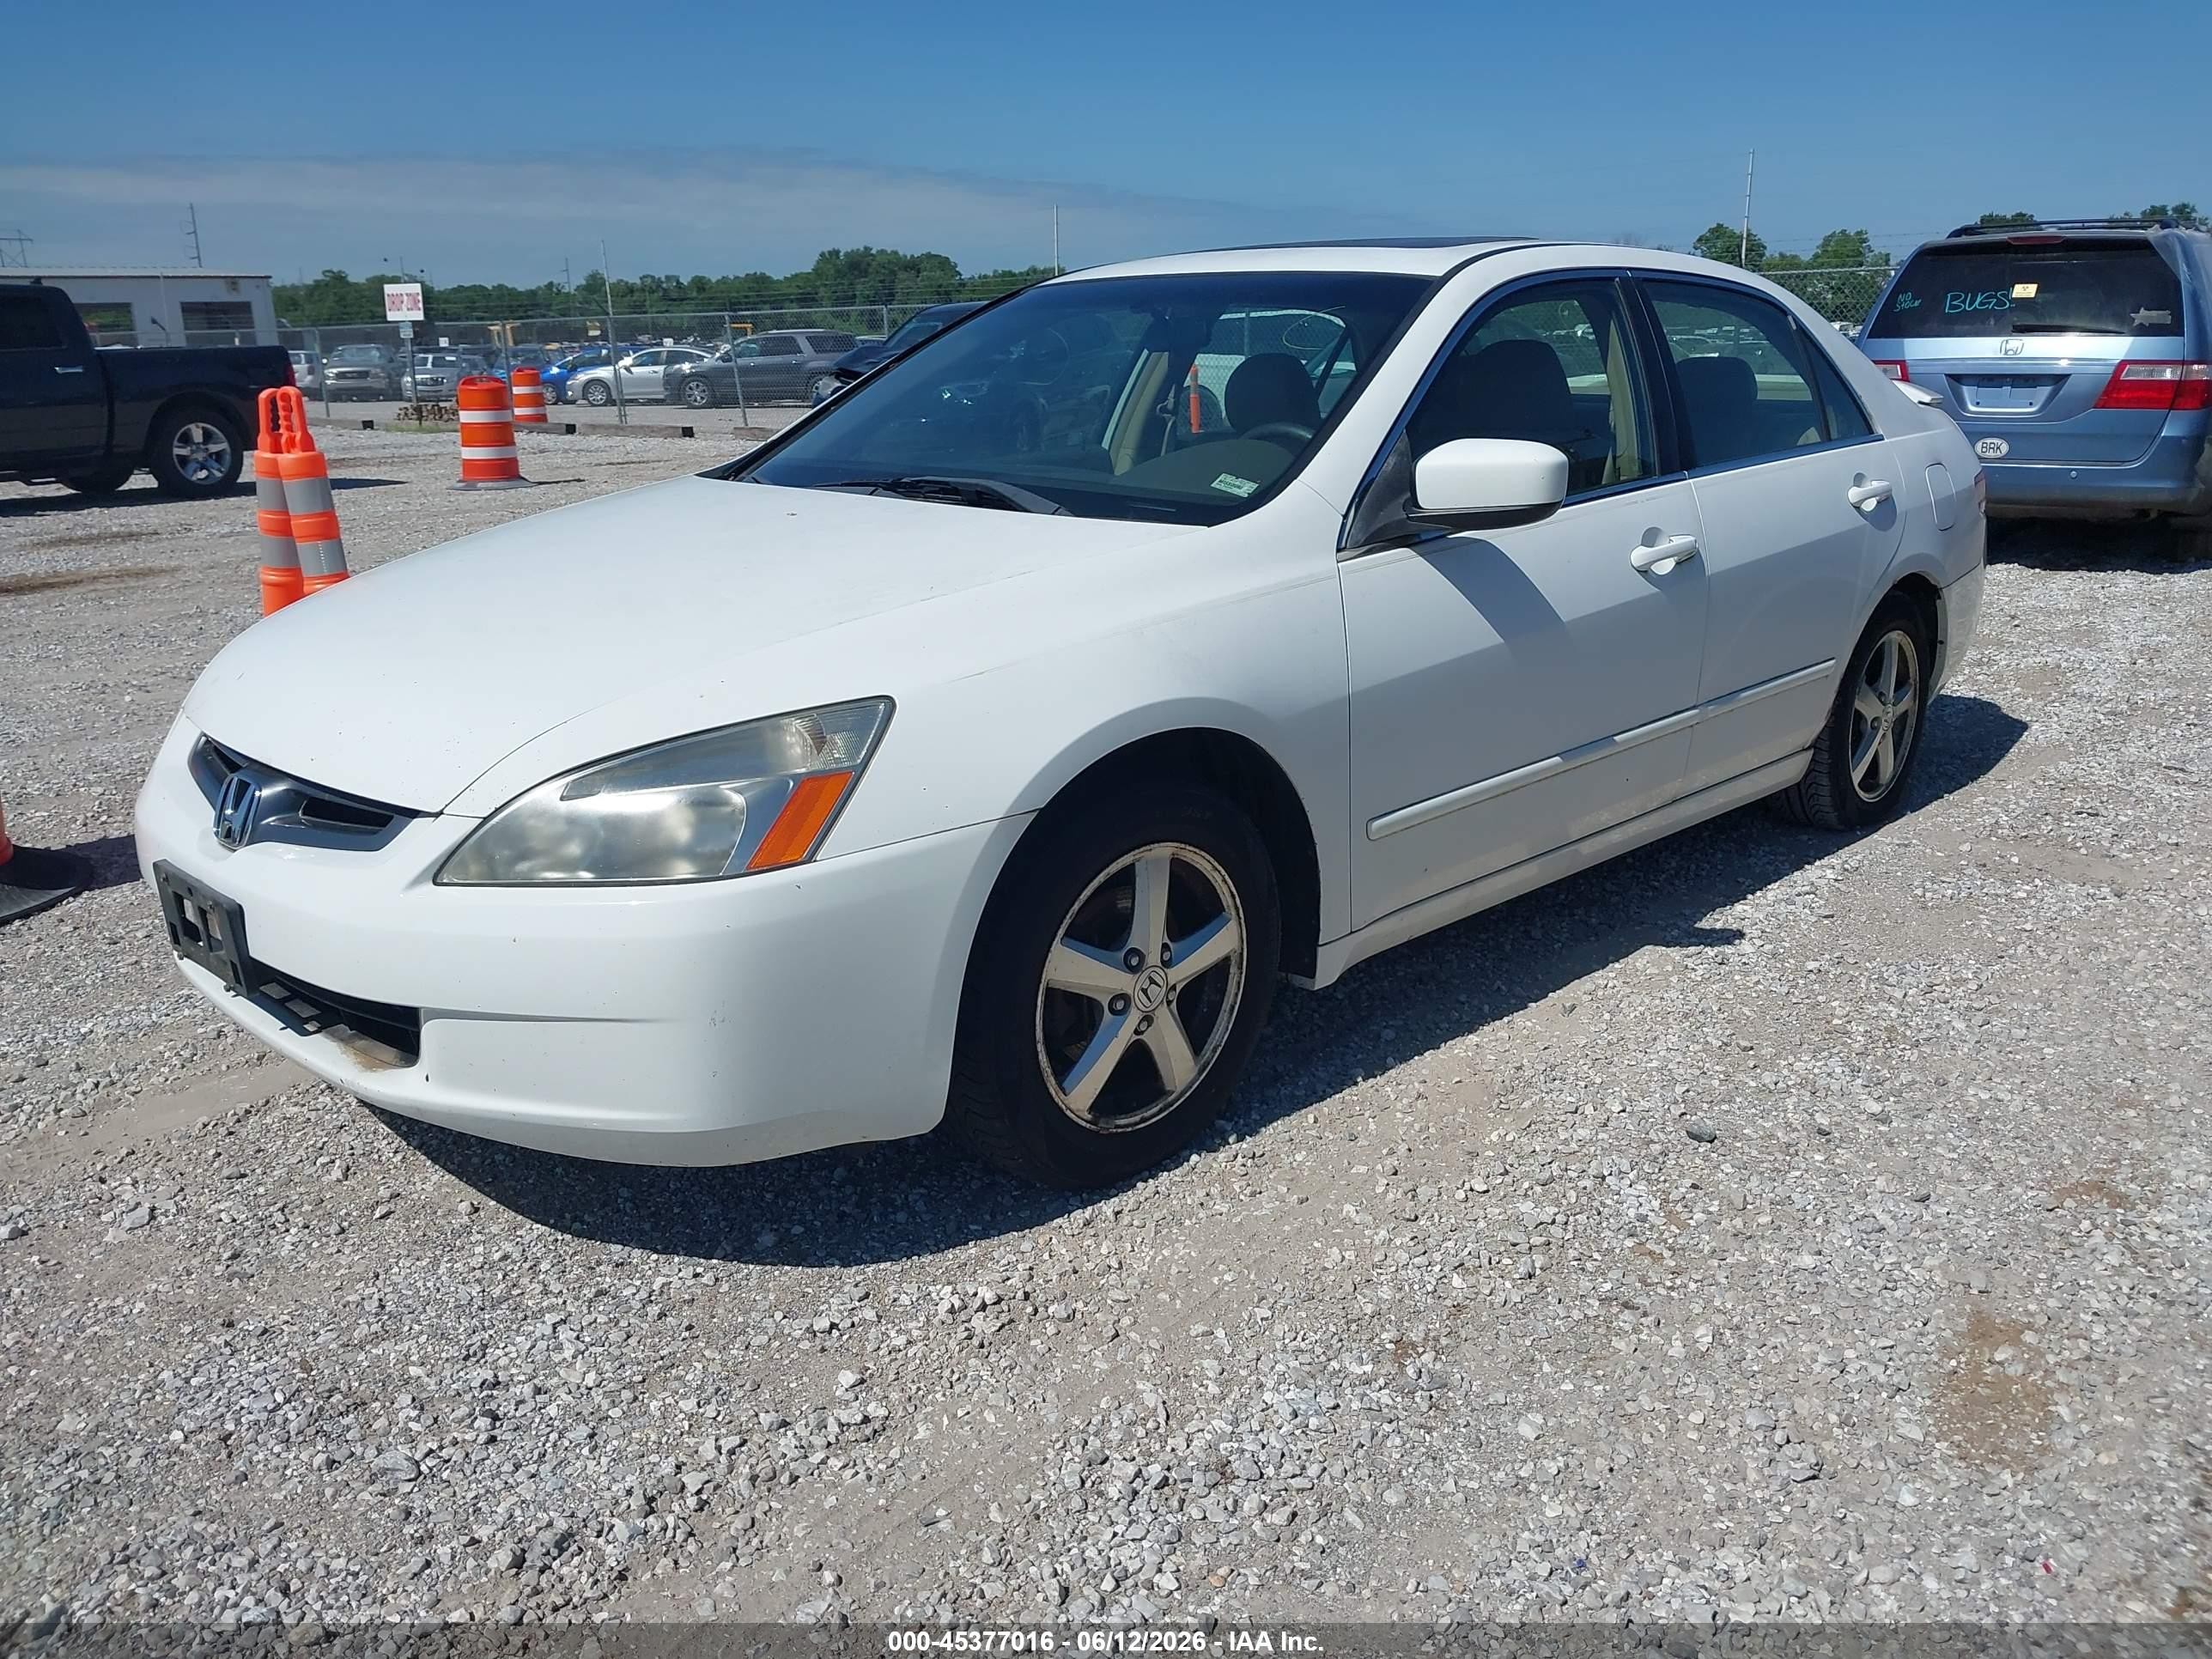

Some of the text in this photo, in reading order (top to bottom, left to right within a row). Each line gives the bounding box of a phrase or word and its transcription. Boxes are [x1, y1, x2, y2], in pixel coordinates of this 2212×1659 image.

[386, 292, 421, 312] DROP ZONE
[1897, 291, 1912, 304] NO
[1980, 441, 2003, 454] BRK
